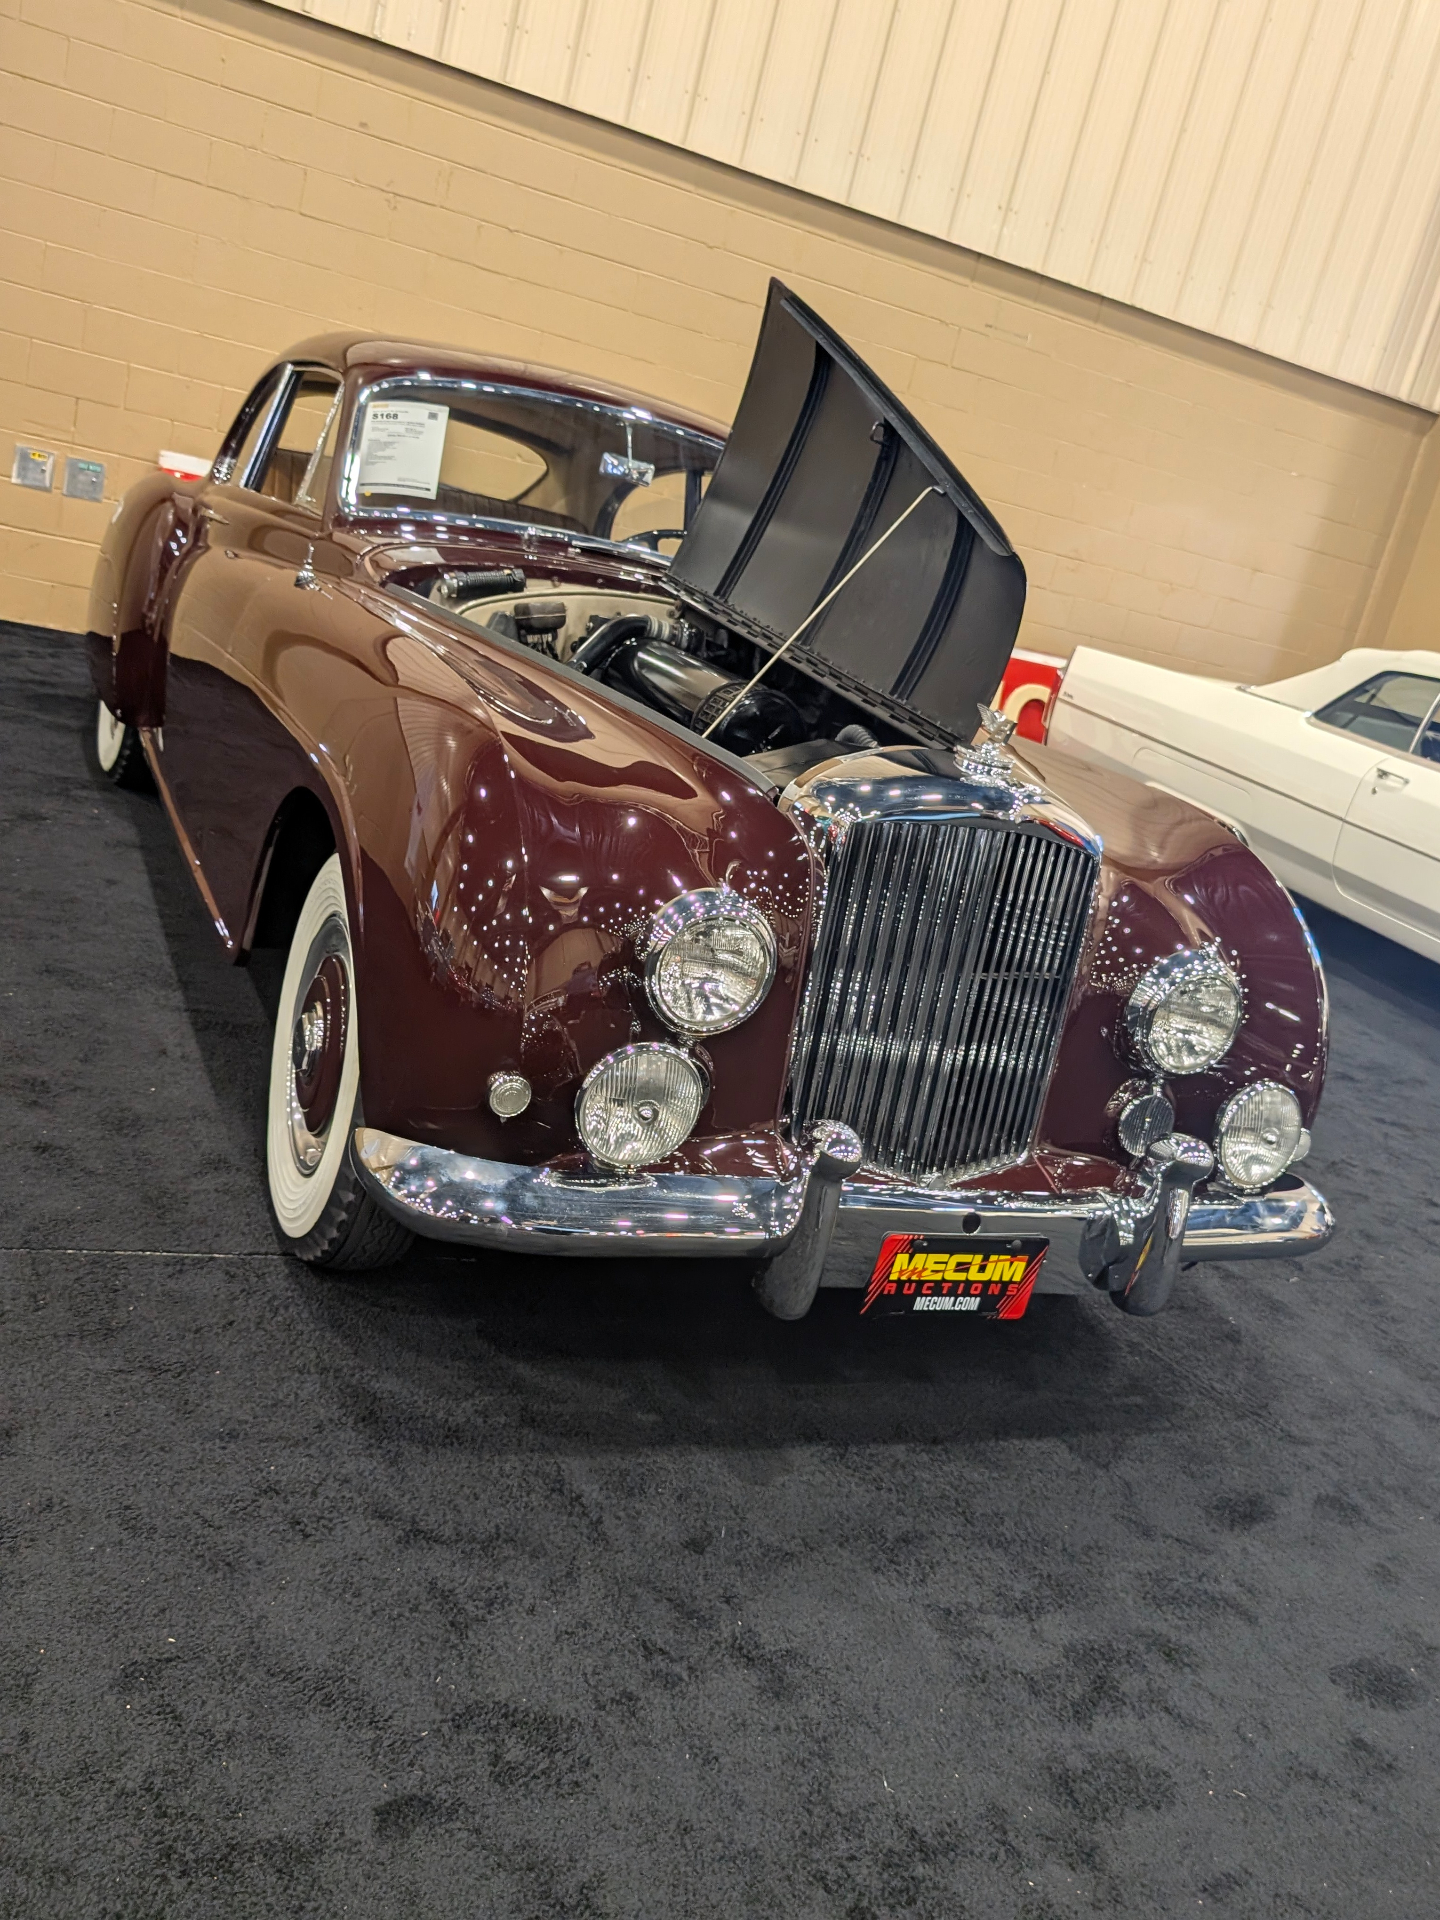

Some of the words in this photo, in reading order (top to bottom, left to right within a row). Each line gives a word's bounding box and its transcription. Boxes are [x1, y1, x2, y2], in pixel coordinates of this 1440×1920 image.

[889, 1253, 1029, 1281] MECUM
[883, 1282, 1019, 1295] AUCTIONS
[913, 1296, 981, 1311] MECUM.COM
